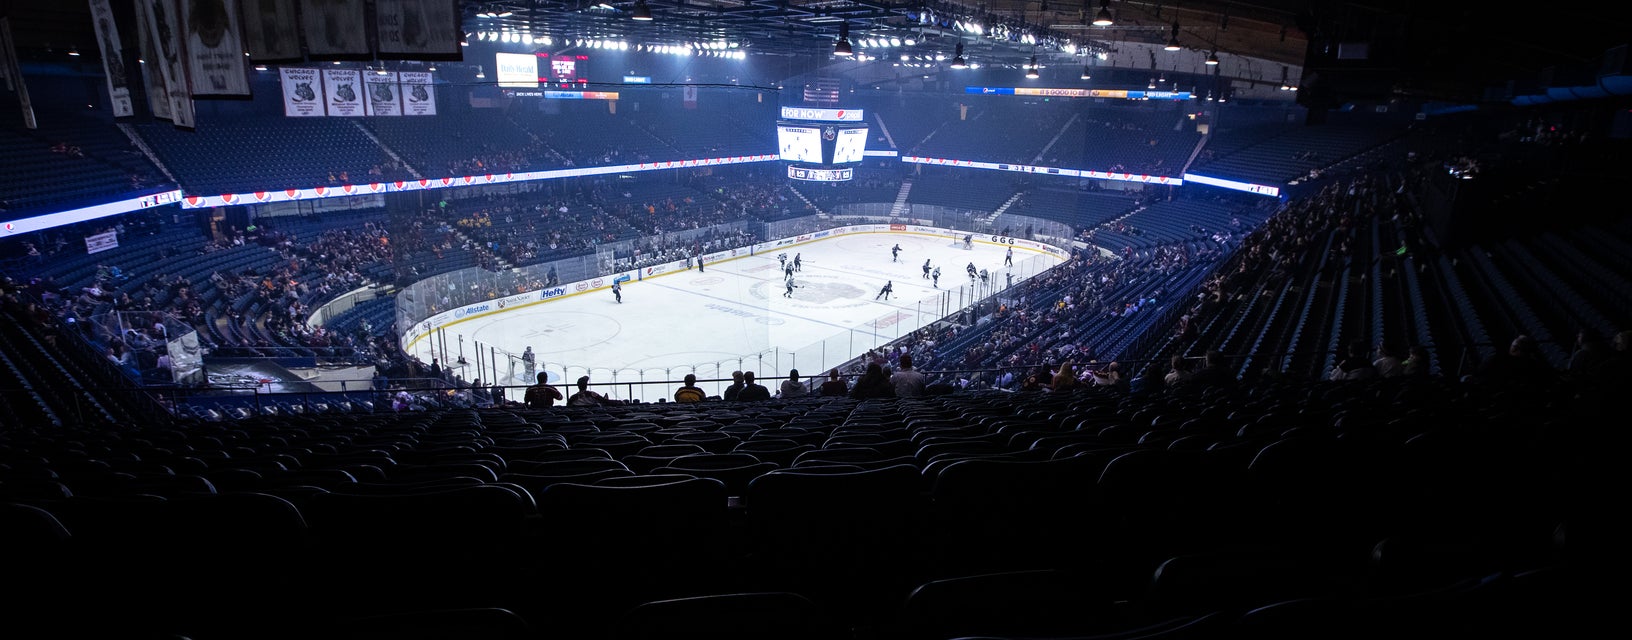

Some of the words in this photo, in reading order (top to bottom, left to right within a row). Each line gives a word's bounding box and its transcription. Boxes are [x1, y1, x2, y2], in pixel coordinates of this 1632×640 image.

[800, 109, 824, 119] NOW
[542, 286, 567, 298] Hefty
[465, 304, 490, 315] Allstate
